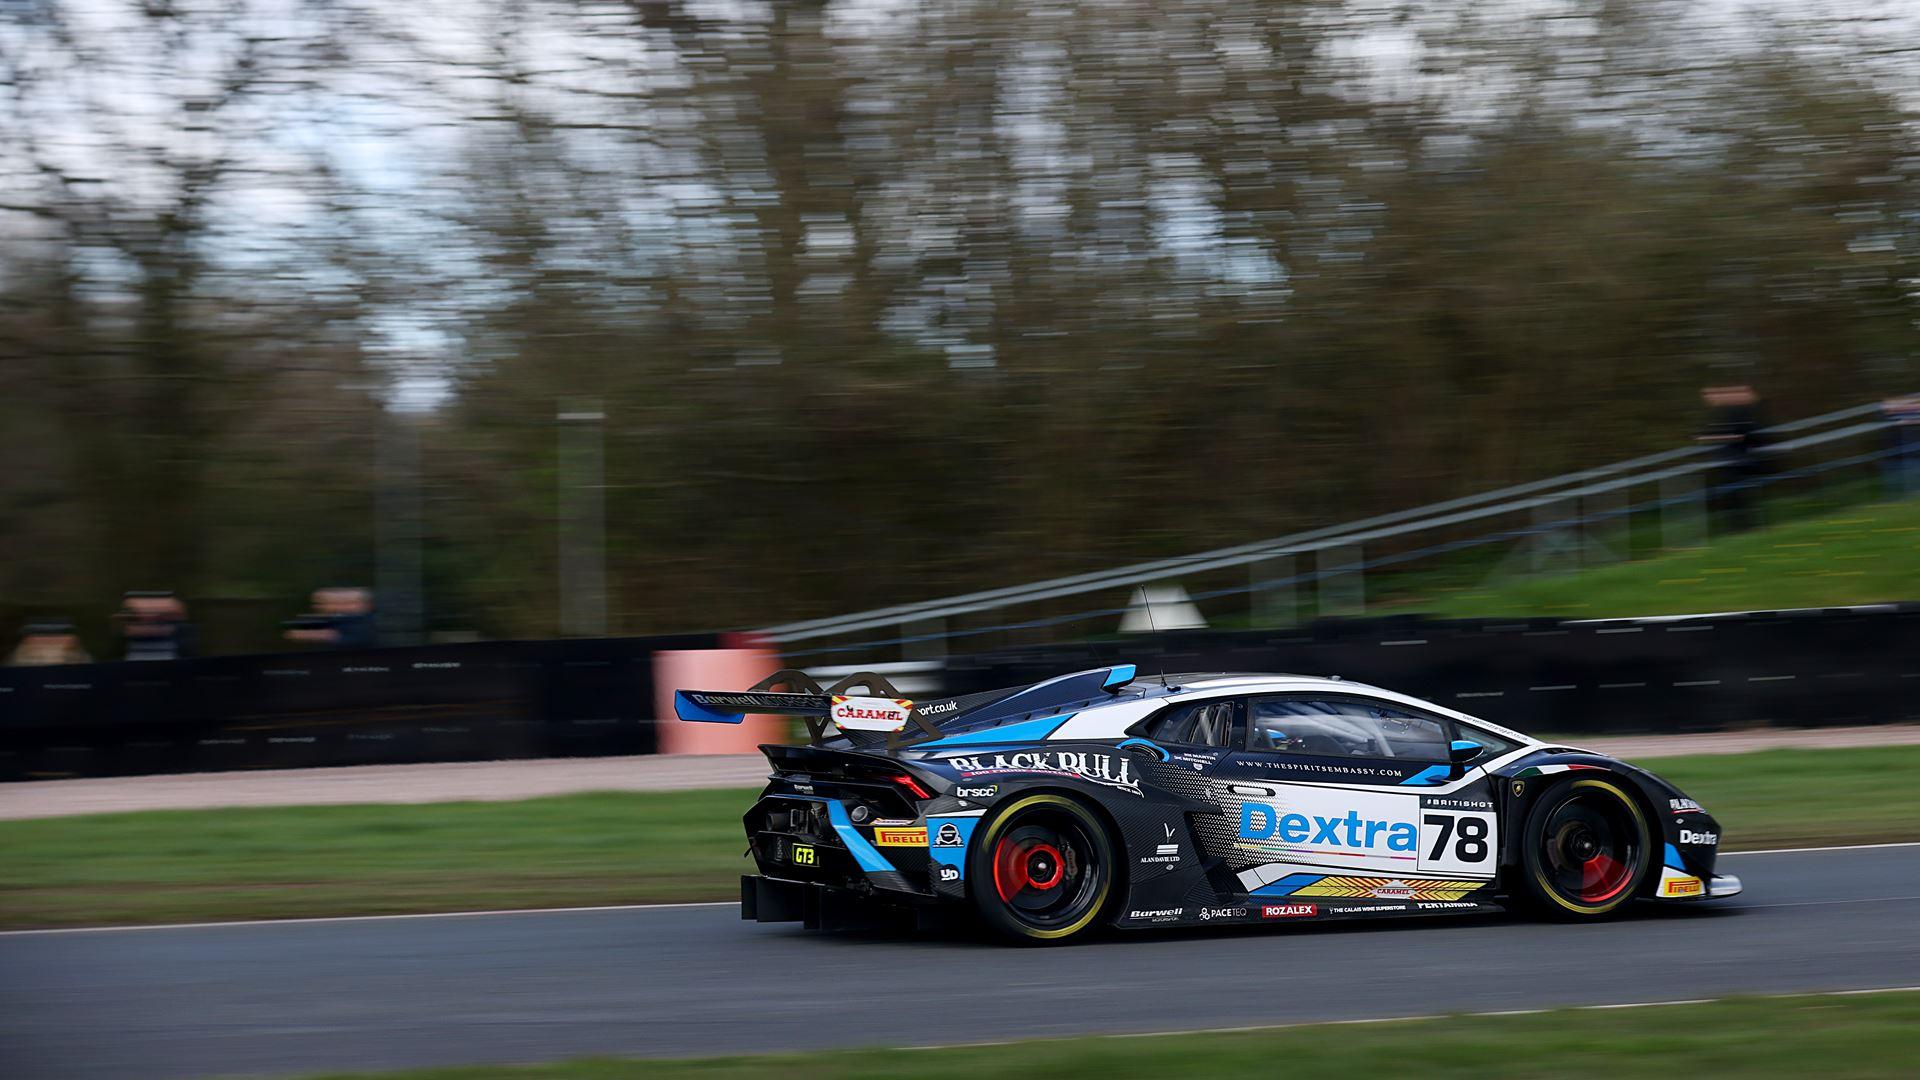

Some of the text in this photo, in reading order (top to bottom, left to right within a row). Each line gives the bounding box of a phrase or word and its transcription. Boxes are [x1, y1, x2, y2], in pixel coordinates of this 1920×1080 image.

[836, 706, 904, 721] CARAMEL
[916, 700, 958, 716] ort.co.uk
[948, 752, 1055, 772] BLACK
[1236, 760, 1403, 777] WWW.THESPIRITSEMBASSY.COM
[956, 786, 995, 797] brscc
[1239, 801, 1418, 851] Dextra
[881, 831, 928, 844] PIRELLI
[1423, 814, 1489, 863] 78
[796, 847, 815, 864] GT3
[1130, 907, 1183, 918] Barwell
[1265, 905, 1313, 916] ROZALEX
